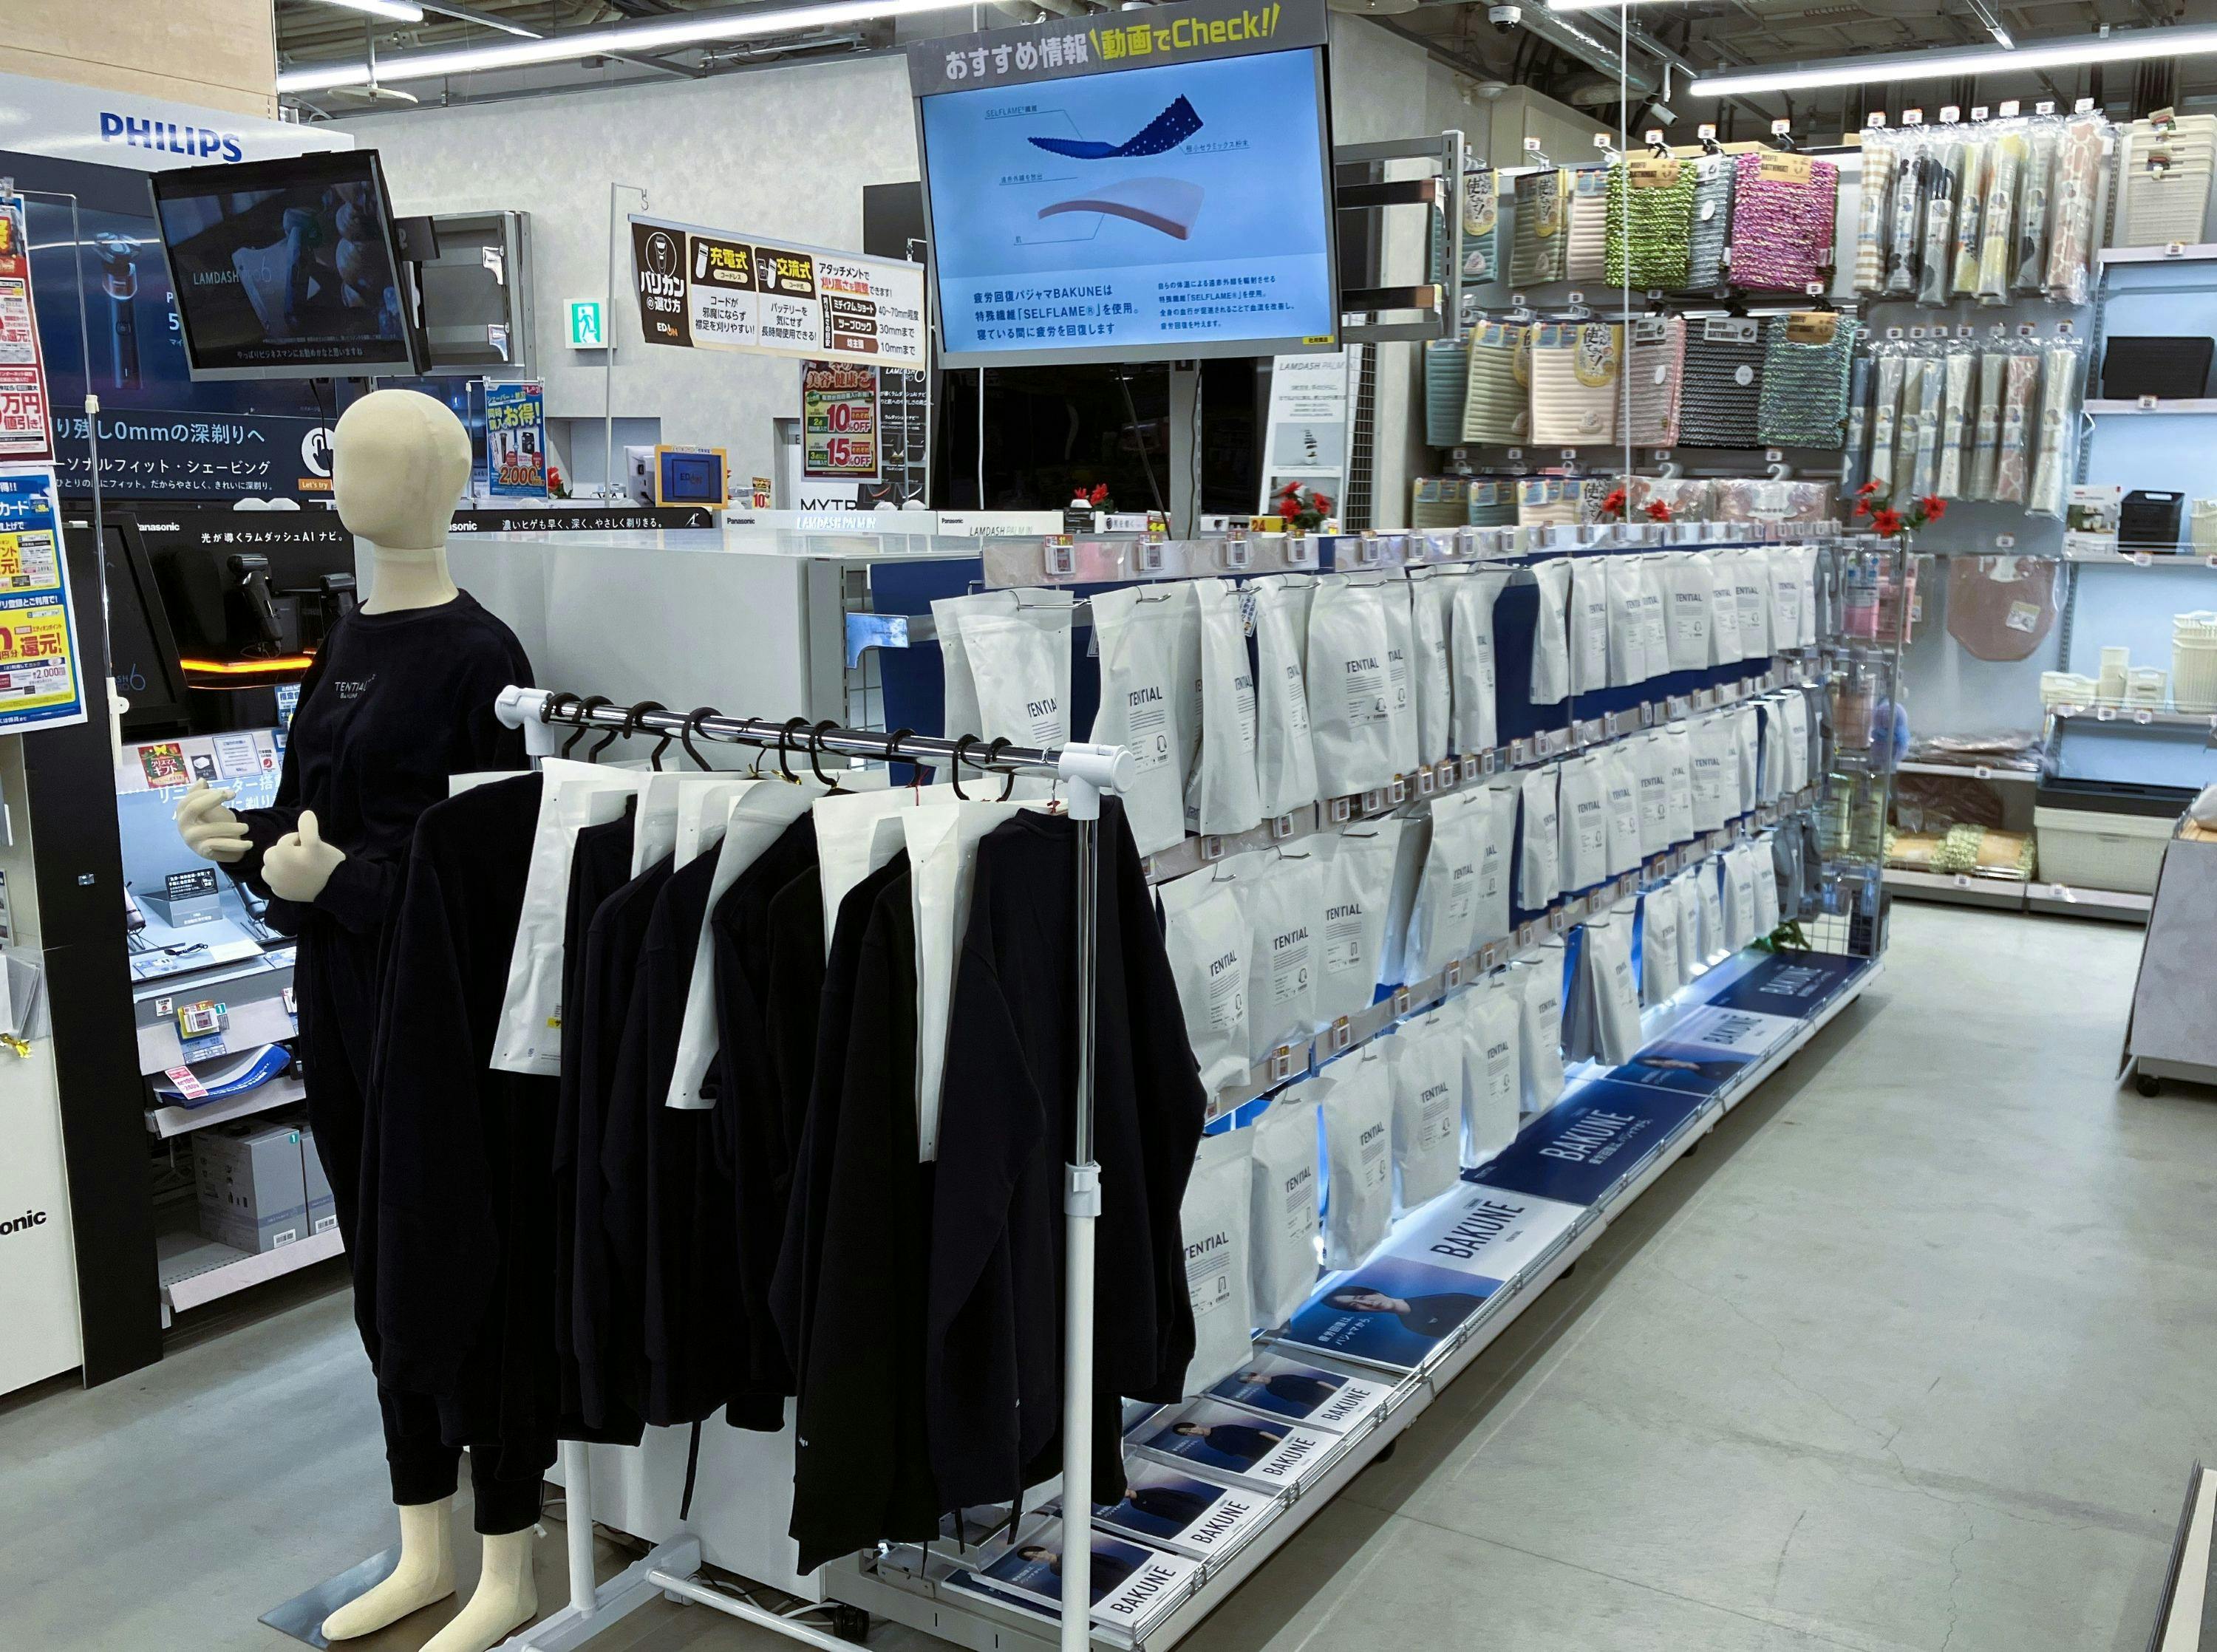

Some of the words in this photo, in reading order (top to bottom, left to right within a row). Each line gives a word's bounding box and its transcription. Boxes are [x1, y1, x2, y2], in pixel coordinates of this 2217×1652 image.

[946, 33, 1089, 81] おすすめ情報
[99, 112, 242, 163] PHILIPS
[711, 248, 749, 270] 充電式
[193, 271, 239, 285] LAMDASH
[777, 258, 812, 280] 交流式
[819, 262, 870, 281] アタッチメントで
[641, 271, 685, 298] バリカン
[711, 297, 738, 308] コードが
[973, 284, 1113, 304] 疲労回復パジャマBAKUNEは
[647, 297, 681, 313] の選び方
[703, 307, 746, 321] 邪魔にならず
[771, 304, 808, 316] バッテリーを
[777, 315, 803, 327] 気にせず
[838, 318, 872, 332] ツーブロック
[879, 324, 915, 338] 30mmまで
[977, 322, 1115, 341] 寝ている間に疲労を回復します
[881, 342, 916, 355] 10mmまで
[50, 417, 266, 445] り残し0mmの深剃りへ
[55, 479, 273, 491] ひとりのにフィット。だからやさしく、きれいに深剃り。
[302, 481, 316, 491] Let's
[317, 481, 328, 491] try
[449, 521, 477, 532] sonic
[727, 517, 755, 525] Panasonic
[970, 527, 1006, 536] LAMDASH
[1675, 593, 1703, 603] TENTIAL
[1735, 586, 1759, 595] ENTIAL
[1345, 656, 1380, 674] TENTIAL
[335, 680, 368, 692] TENTIAL
[1128, 686, 1162, 707] TENTIAL
[154, 765, 179, 777] ギフト
[1695, 757, 1720, 768] TENTIAL
[1641, 776, 1664, 788] TENTIAL
[1578, 800, 1601, 813] TENTIAL
[1326, 903, 1362, 921] TENTIAL
[1273, 926, 1310, 950] TENTIAL
[1210, 950, 1237, 976] TENTIAL
[1487, 1040, 1509, 1060] TENTIAL
[1420, 1082, 1448, 1103] TENTIAL
[1360, 1121, 1384, 1146] TENTIAL
[1539, 1109, 1635, 1162] BAKUNE
[1286, 1166, 1312, 1194] TENTIAL
[1430, 1200, 1526, 1260] BAKUNE
[1321, 1387, 1372, 1422] BAKUNE
[1262, 1437, 1316, 1477] BAKUNE
[1191, 1500, 1250, 1546] BAKUNE
[1110, 1565, 1177, 1615] BAKUNE
